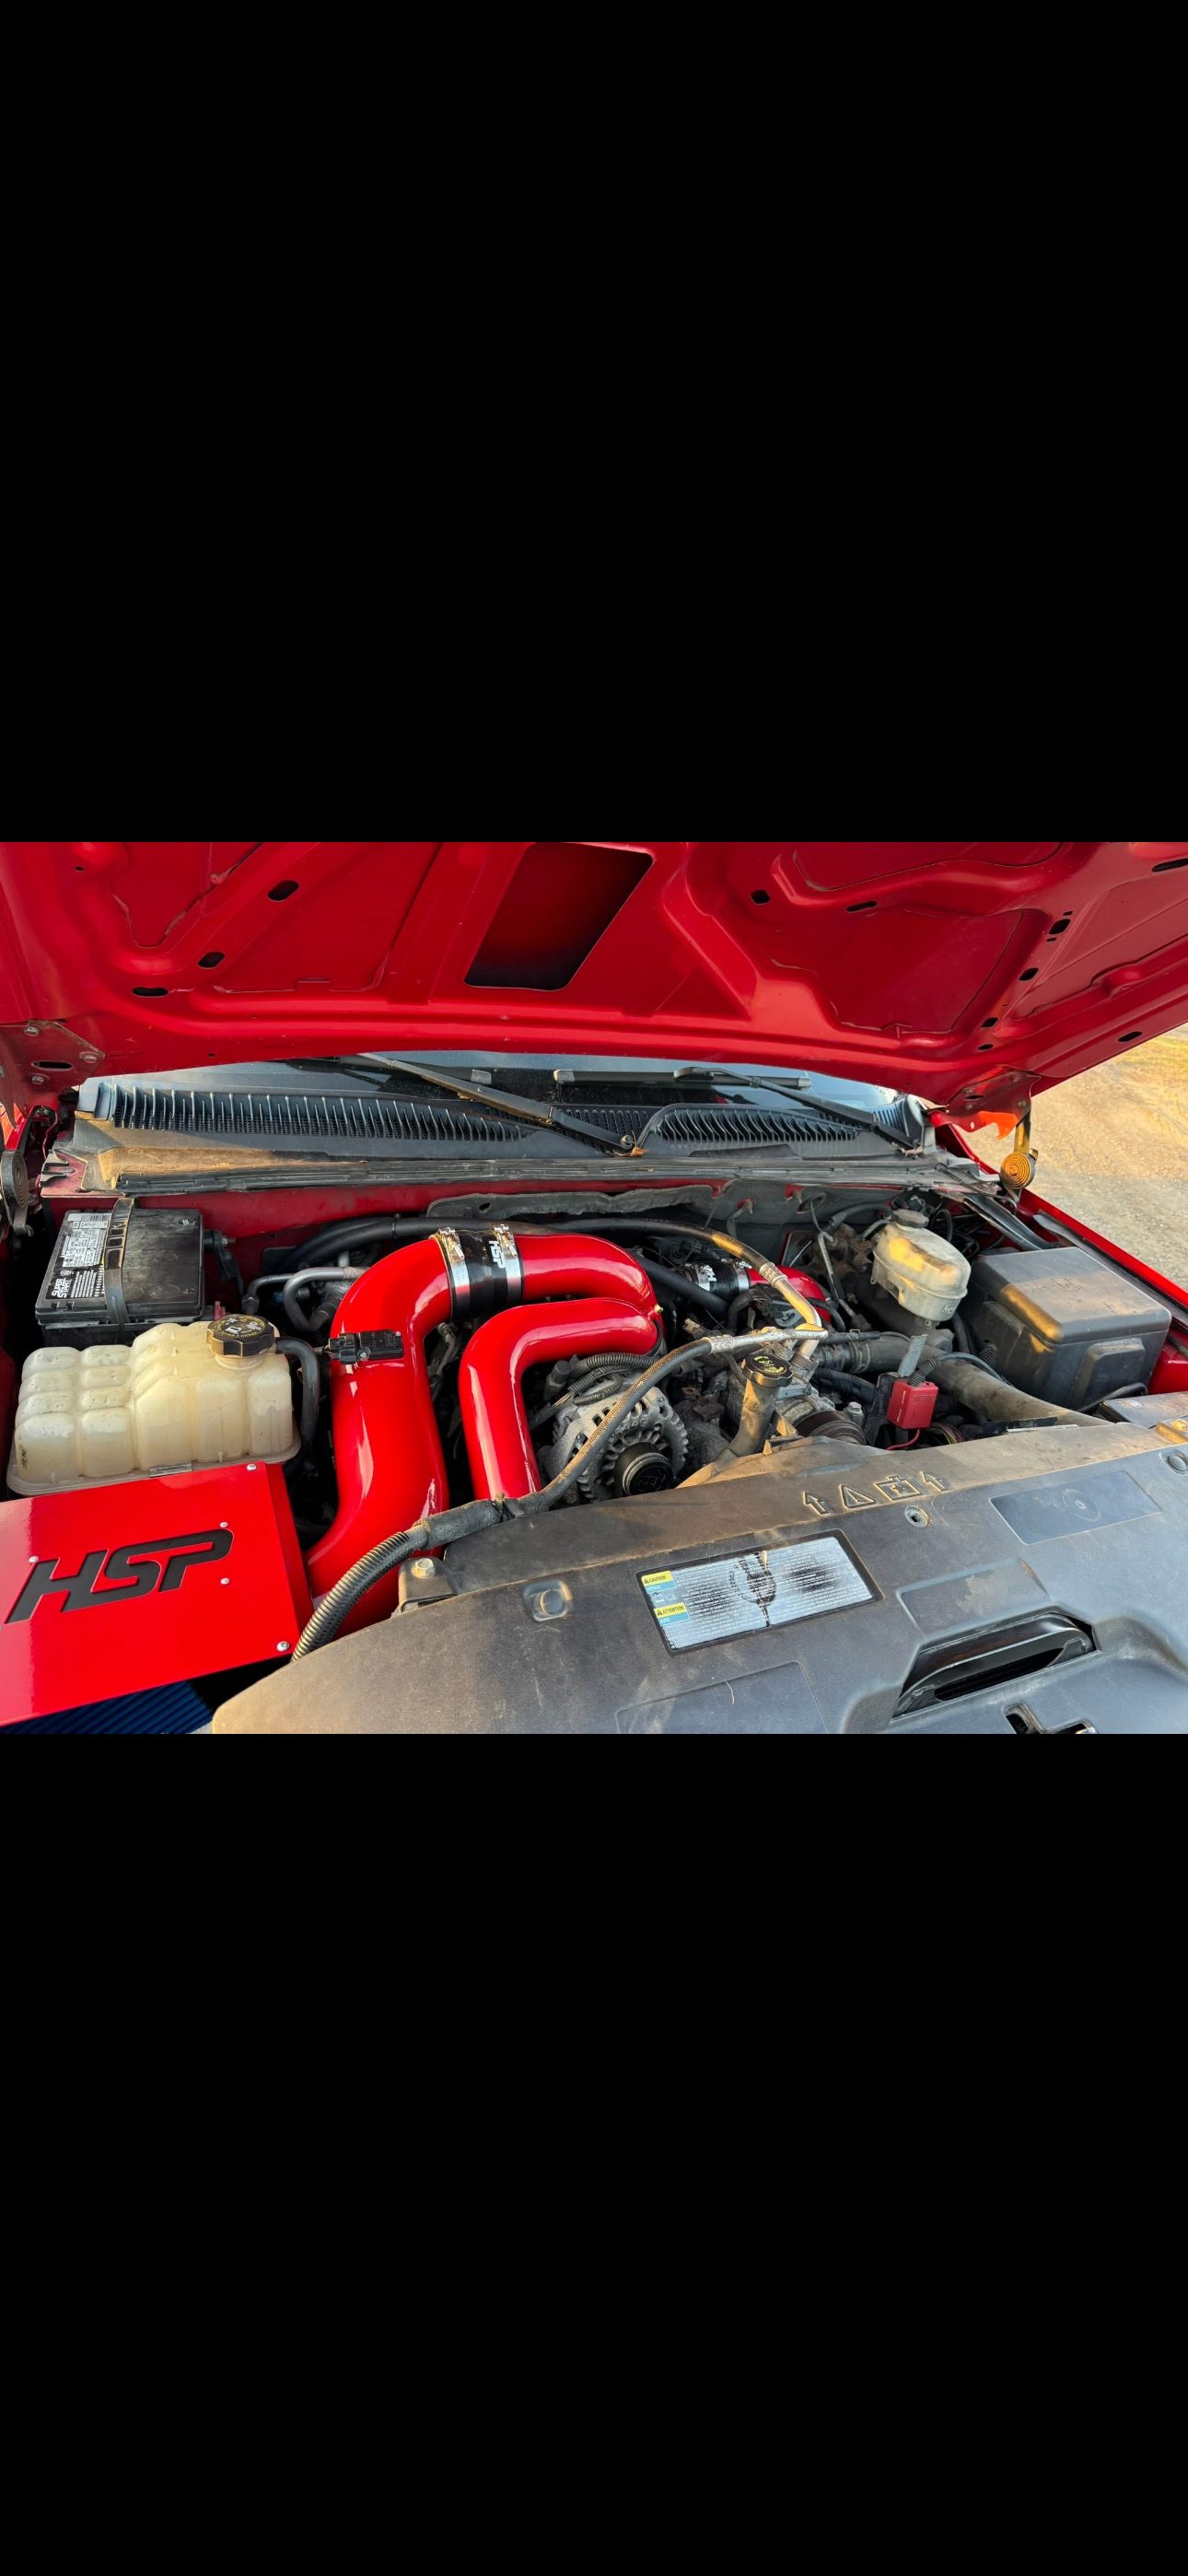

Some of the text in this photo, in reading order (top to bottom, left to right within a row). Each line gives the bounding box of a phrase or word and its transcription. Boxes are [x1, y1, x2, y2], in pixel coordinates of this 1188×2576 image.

[488, 1240, 506, 1269] HSP
[52, 1278, 64, 1296] SUPER
[57, 1277, 73, 1298] START
[5, 1528, 234, 1624] HSP
[662, 1606, 684, 1614] ATTENTION
